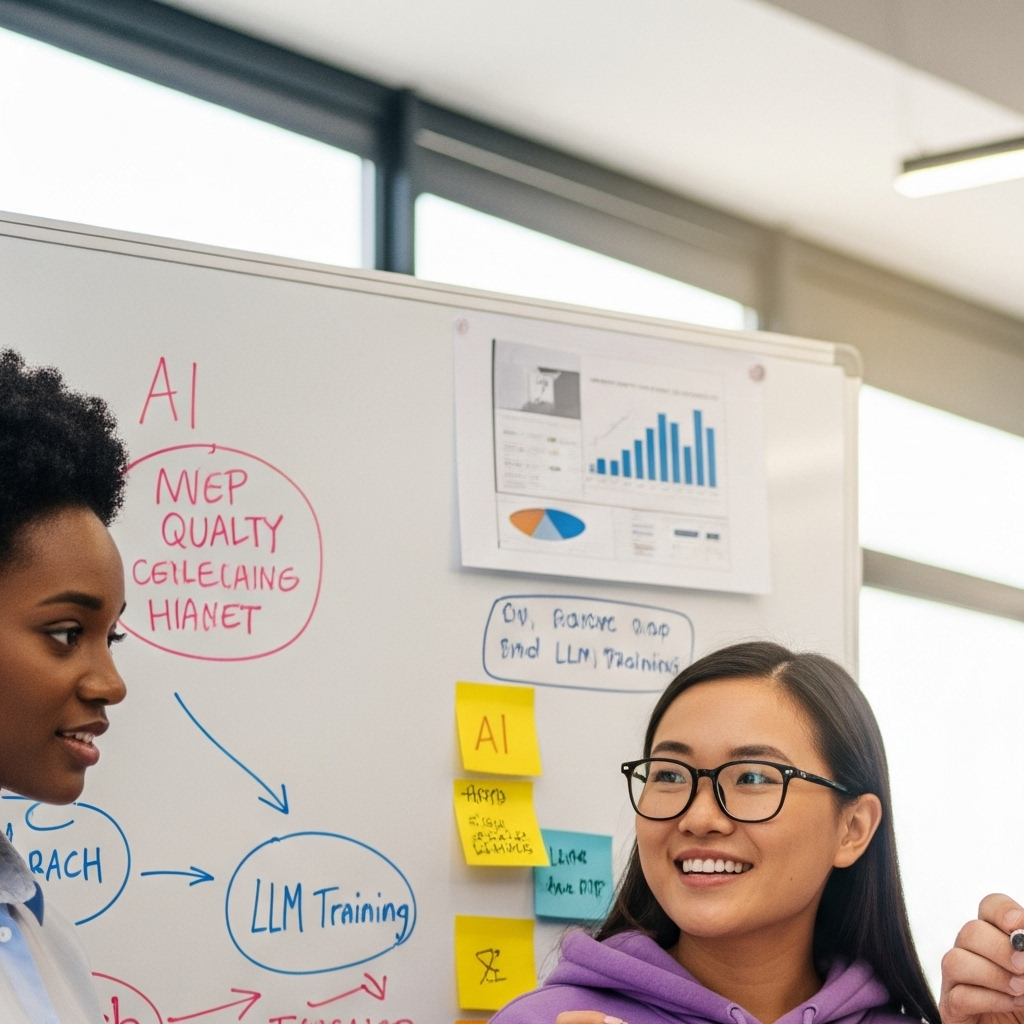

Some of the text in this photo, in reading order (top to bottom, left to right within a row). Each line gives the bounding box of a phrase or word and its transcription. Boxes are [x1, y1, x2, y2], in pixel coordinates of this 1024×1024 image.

[139, 356, 197, 429] AI
[161, 511, 284, 553] QUALTY
[475, 714, 508, 754] AI
[251, 878, 409, 943] LLM Training
